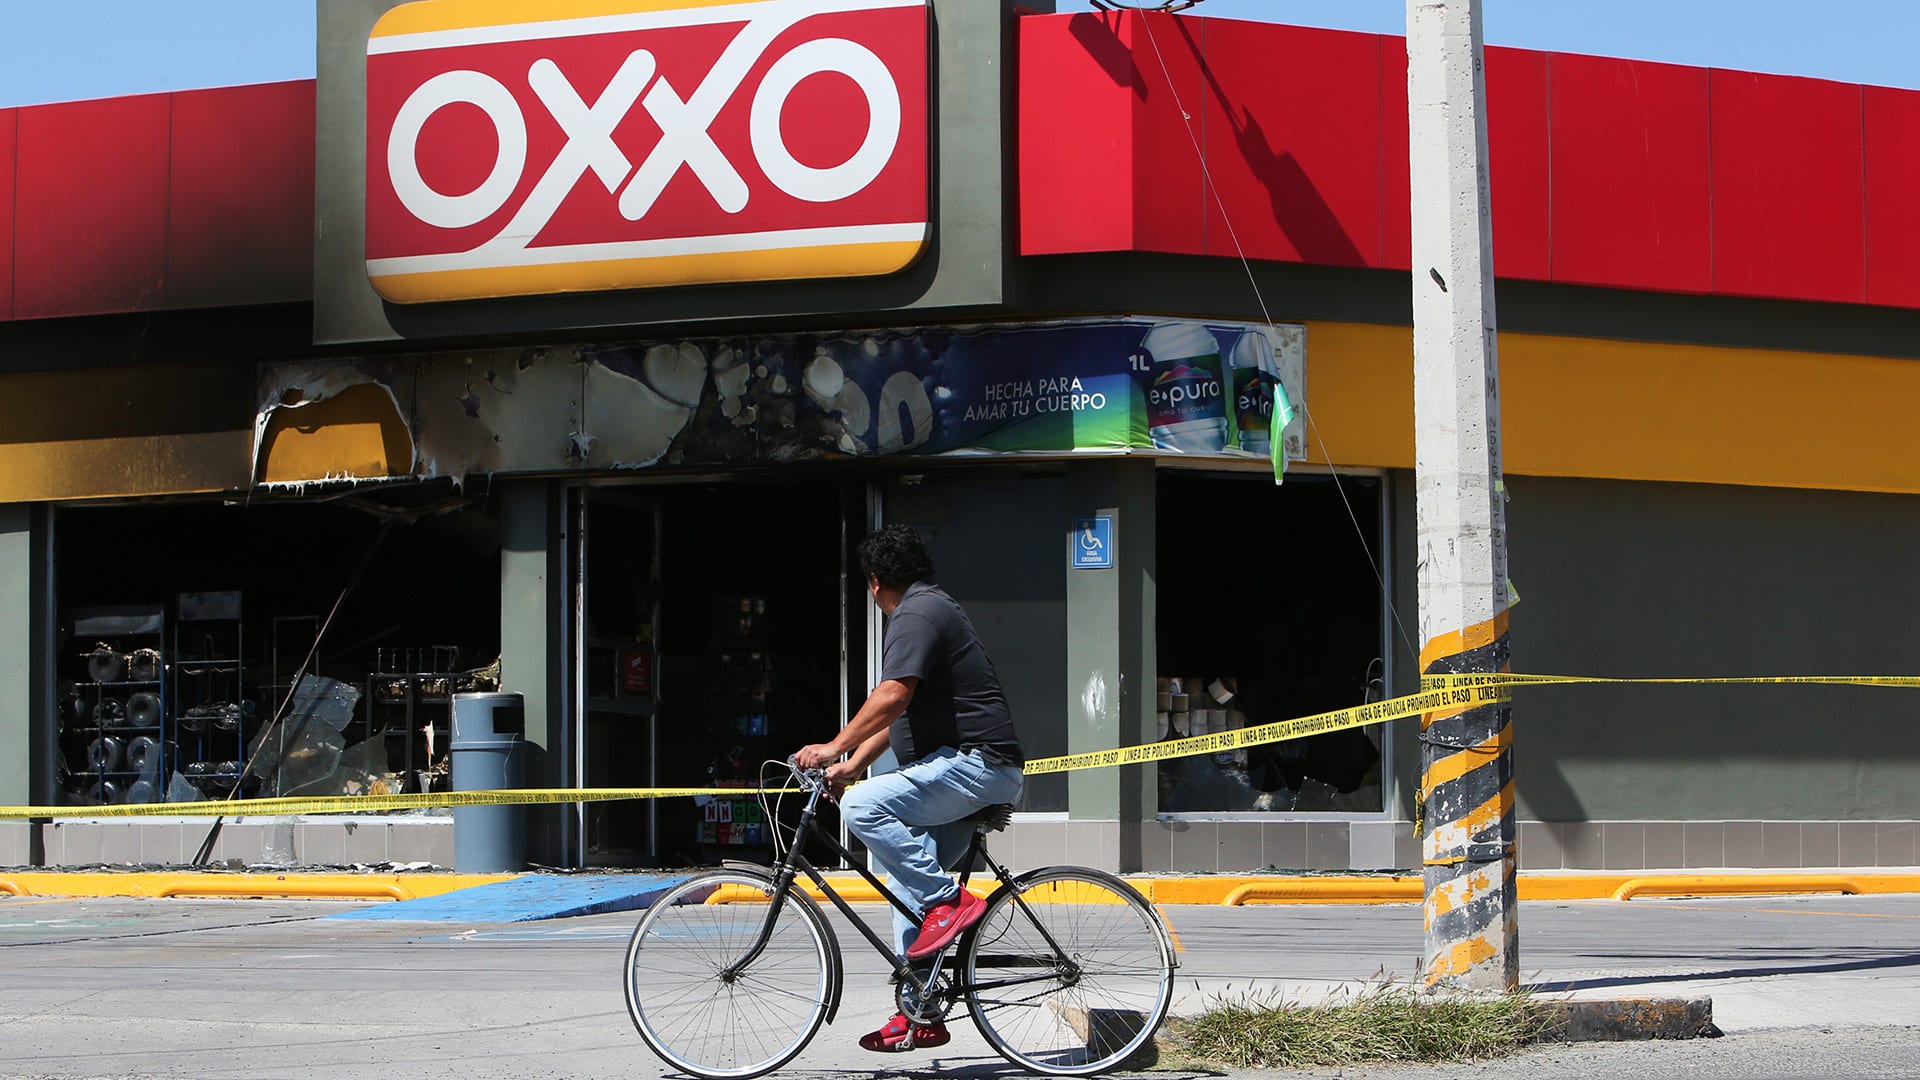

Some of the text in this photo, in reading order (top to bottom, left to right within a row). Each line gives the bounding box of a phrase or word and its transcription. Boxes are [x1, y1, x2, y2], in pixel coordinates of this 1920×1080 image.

[387, 22, 901, 246] OXXO
[1128, 354, 1150, 371] 1L
[985, 376, 1083, 401] HECHA PARA
[963, 392, 1106, 422] AMAR TU CUERPO
[1452, 677, 1473, 687] LINEA
[1475, 676, 1485, 685] DE
[1025, 763, 1034, 773] DE
[1035, 759, 1058, 772] POLICIA
[1059, 755, 1092, 769] PROHIBIDO
[1093, 754, 1101, 764] EL
[1102, 751, 1118, 764] PASO
[1123, 748, 1141, 762] LINEA
[1142, 747, 1150, 759] DE
[1151, 743, 1175, 757] POLICIA
[1176, 739, 1209, 755] PROHIBIDO
[1210, 737, 1218, 748] EL
[1219, 734, 1234, 746] PASO
[1240, 730, 1257, 744] LINEA
[1258, 728, 1266, 741] DE
[1267, 723, 1291, 739] POLICIA
[1292, 717, 1325, 735] PROHIBIDO
[1326, 715, 1334, 728] EL
[1335, 711, 1350, 726] PASO
[1354, 708, 1372, 722] LINEA
[1373, 706, 1381, 719] DE
[1382, 700, 1406, 717] POLICIA
[1407, 693, 1440, 712] PROHIBIDO
[1442, 692, 1450, 705] EL
[1452, 688, 1470, 703] PASO
[1478, 686, 1497, 701] LINEA
